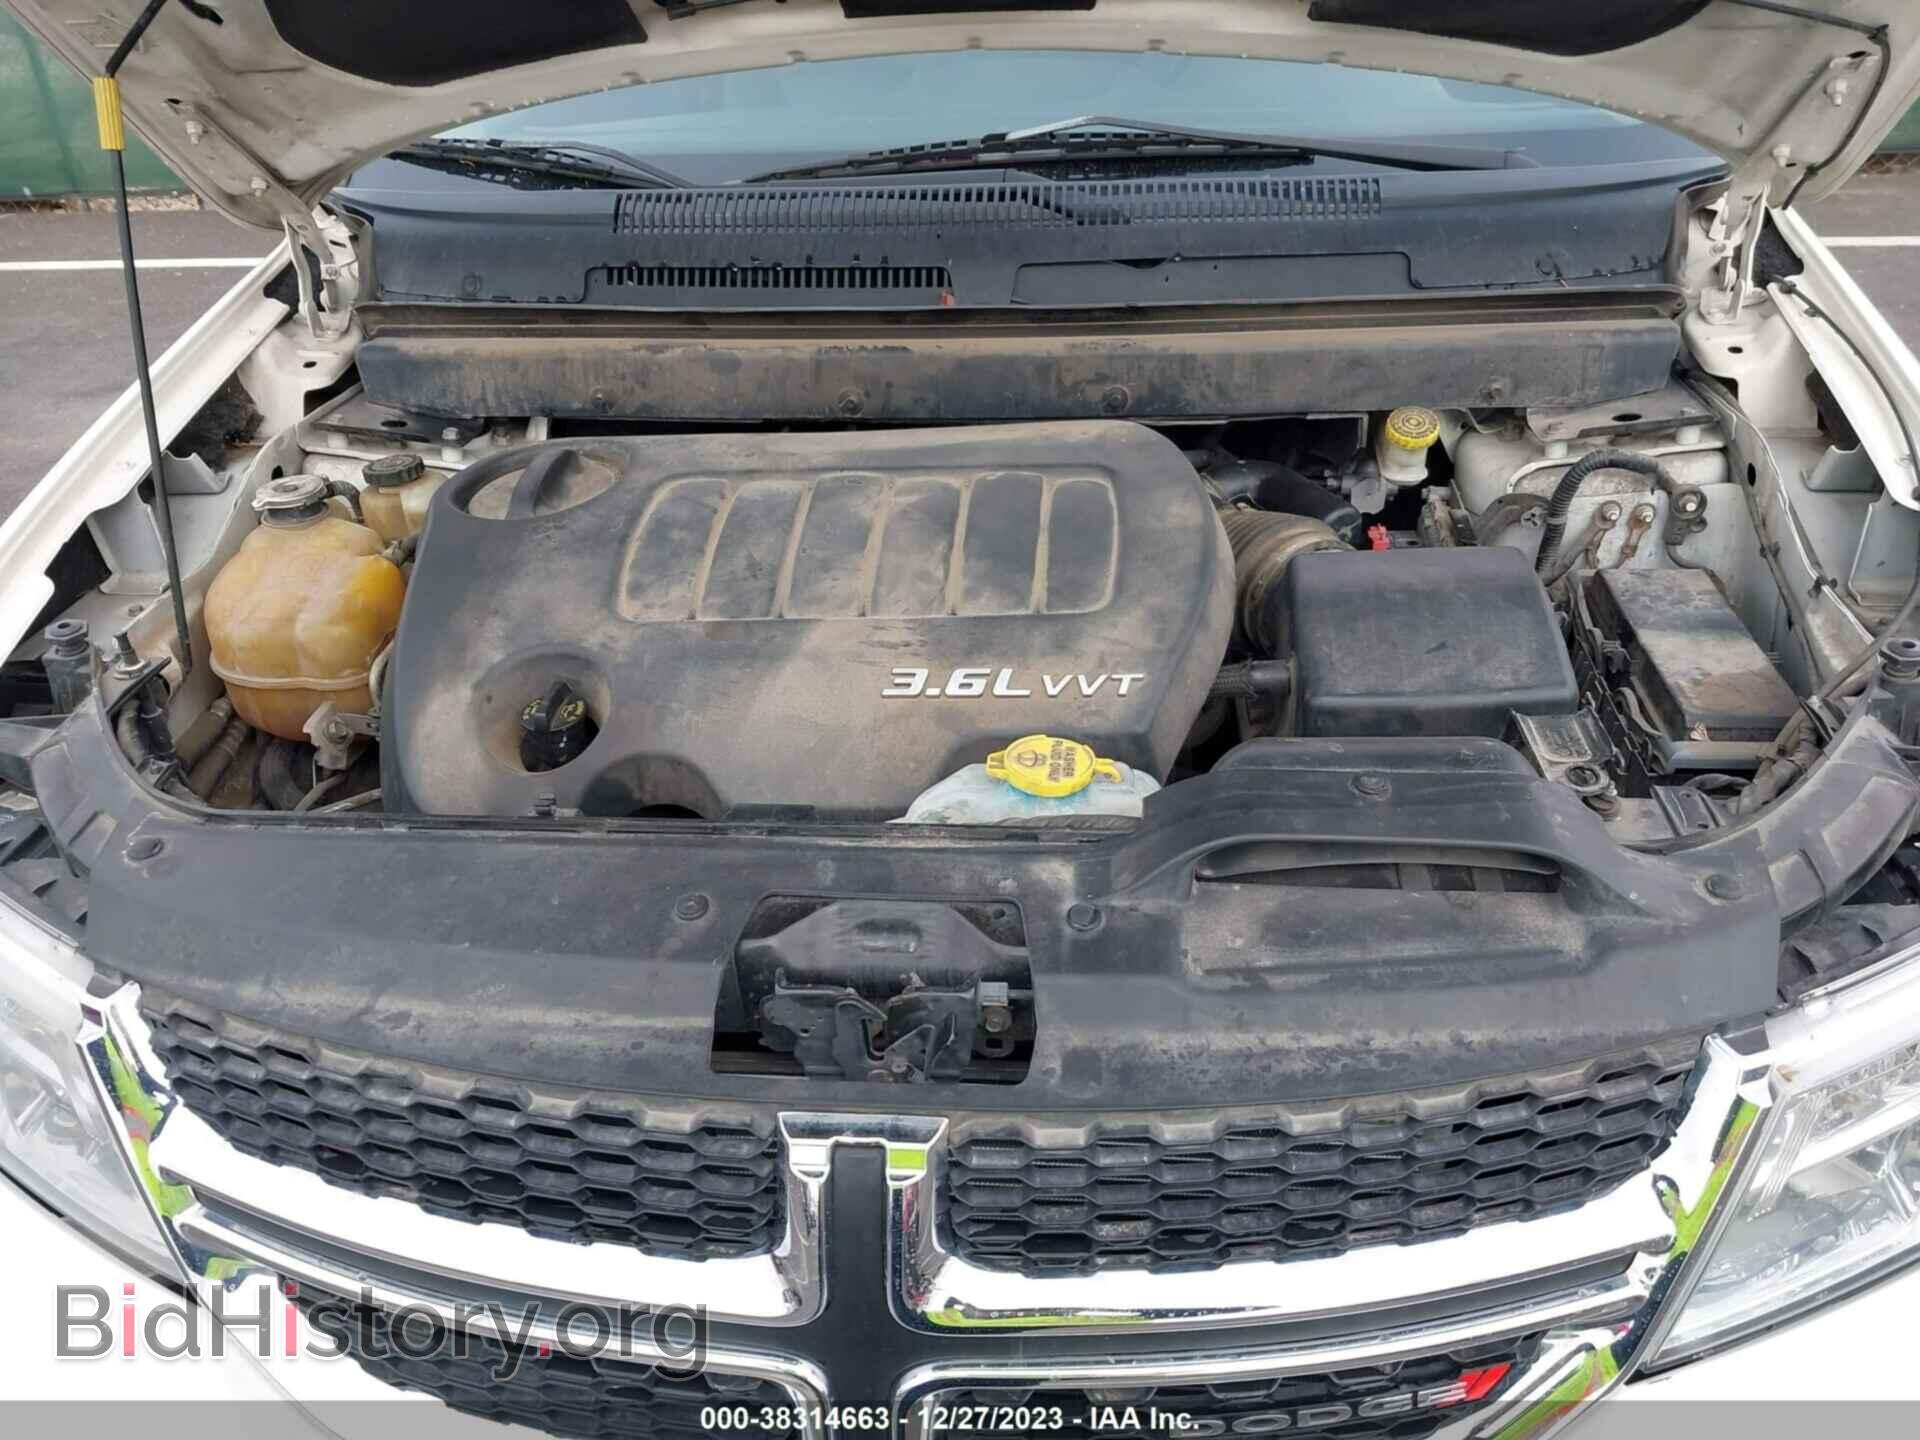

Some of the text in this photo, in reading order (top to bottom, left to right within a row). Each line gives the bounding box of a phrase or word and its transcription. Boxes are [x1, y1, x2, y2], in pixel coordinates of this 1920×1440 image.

[881, 667, 1145, 697] 3.6L VVT
[1170, 1382, 1470, 1436] DODGE
